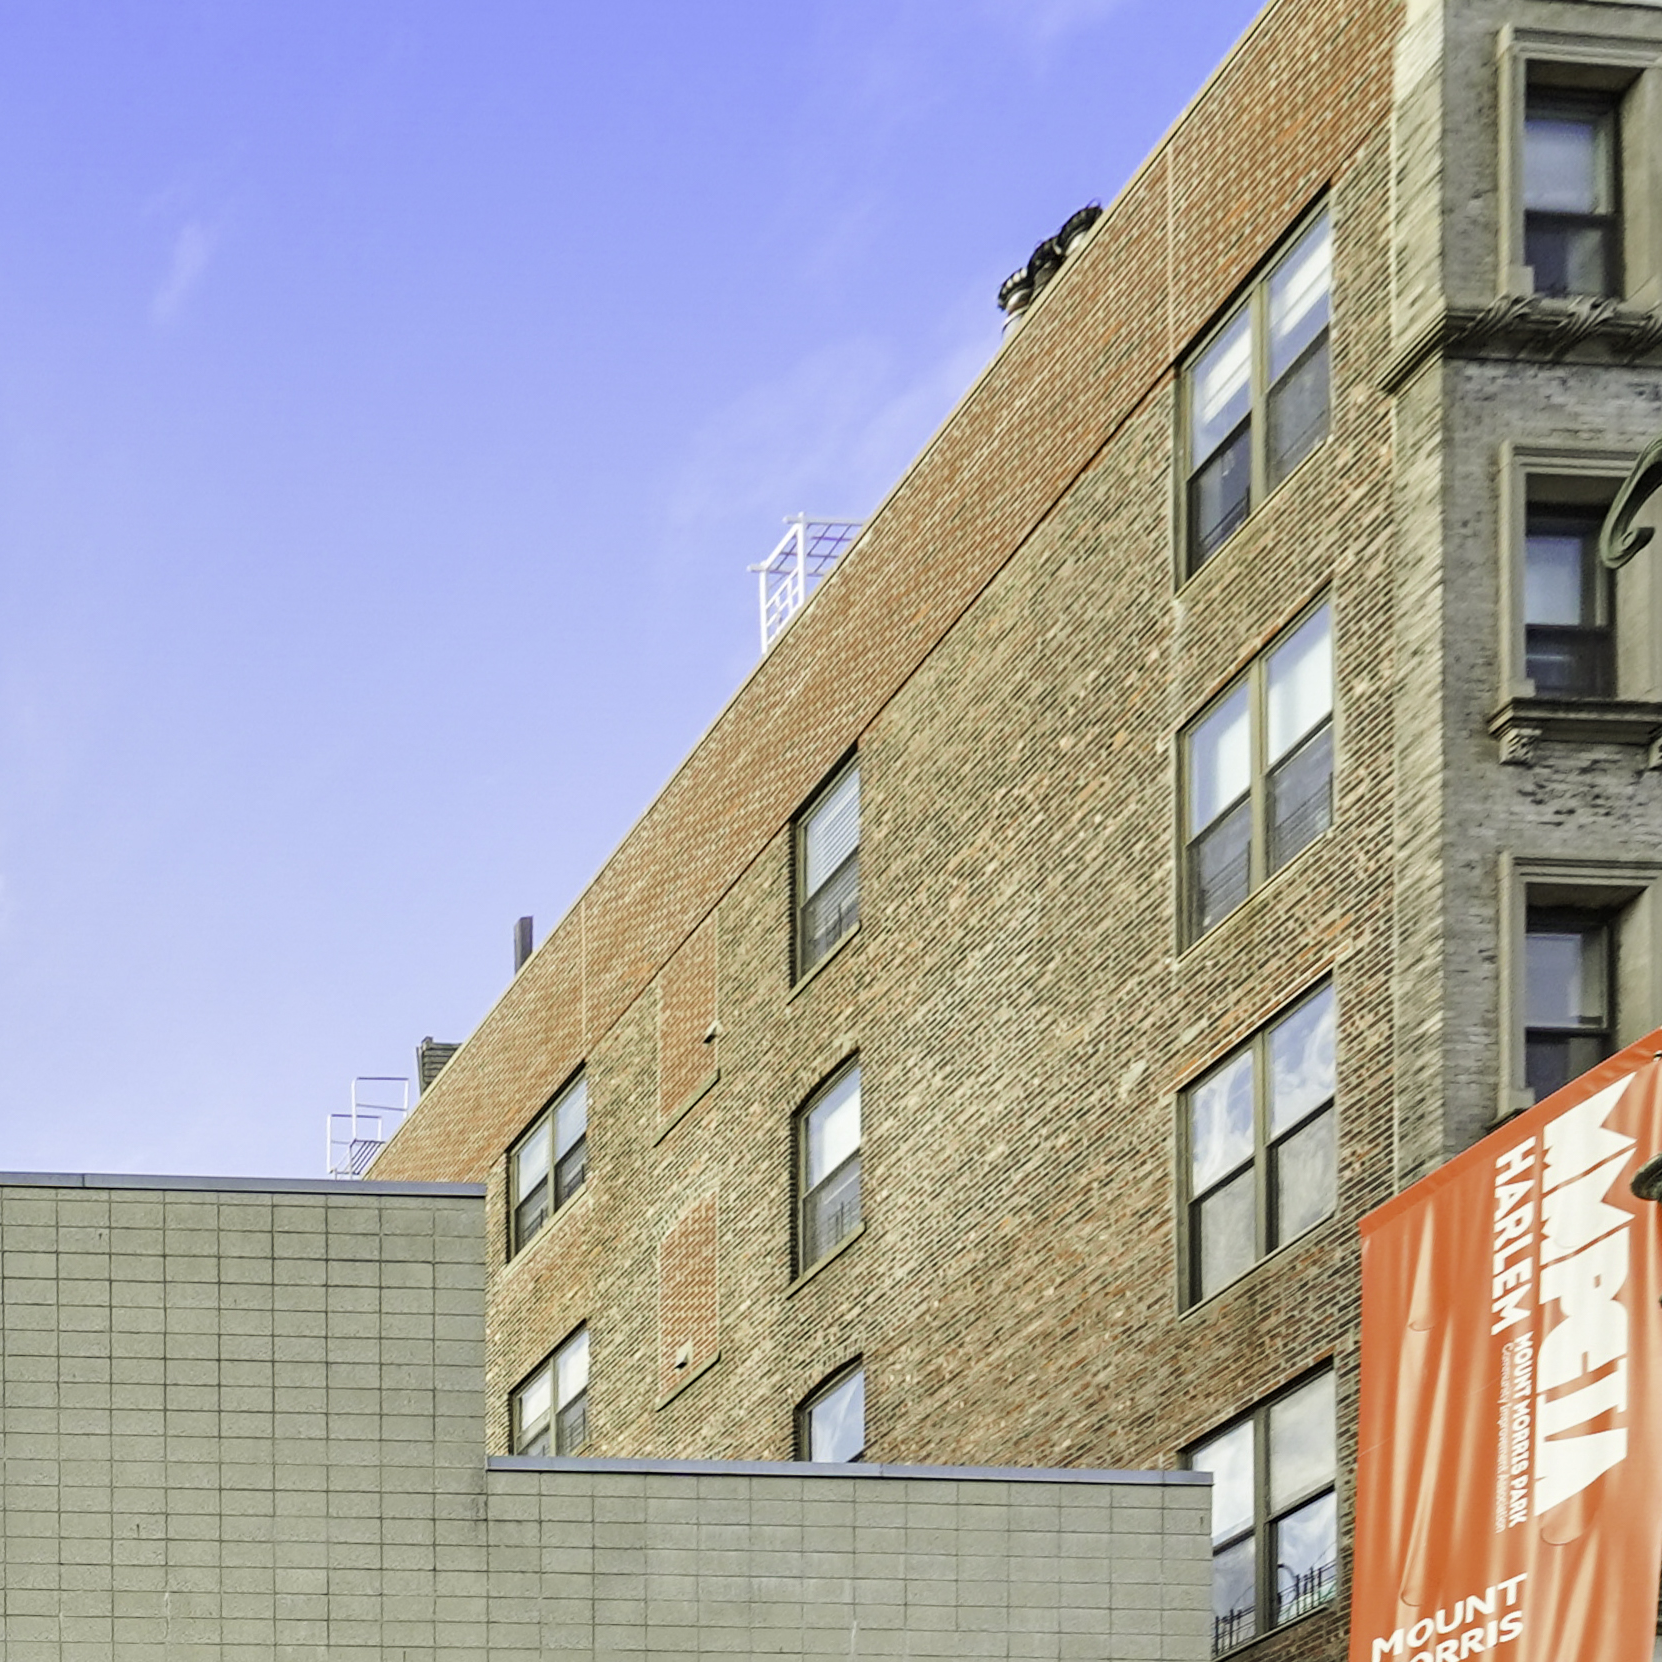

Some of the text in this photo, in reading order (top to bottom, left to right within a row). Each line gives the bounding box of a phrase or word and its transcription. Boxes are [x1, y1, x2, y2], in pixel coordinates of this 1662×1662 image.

[1491, 1136, 1536, 1335] HARLEM
[1508, 1331, 1534, 1528] MOUNT MORRIS PARK
